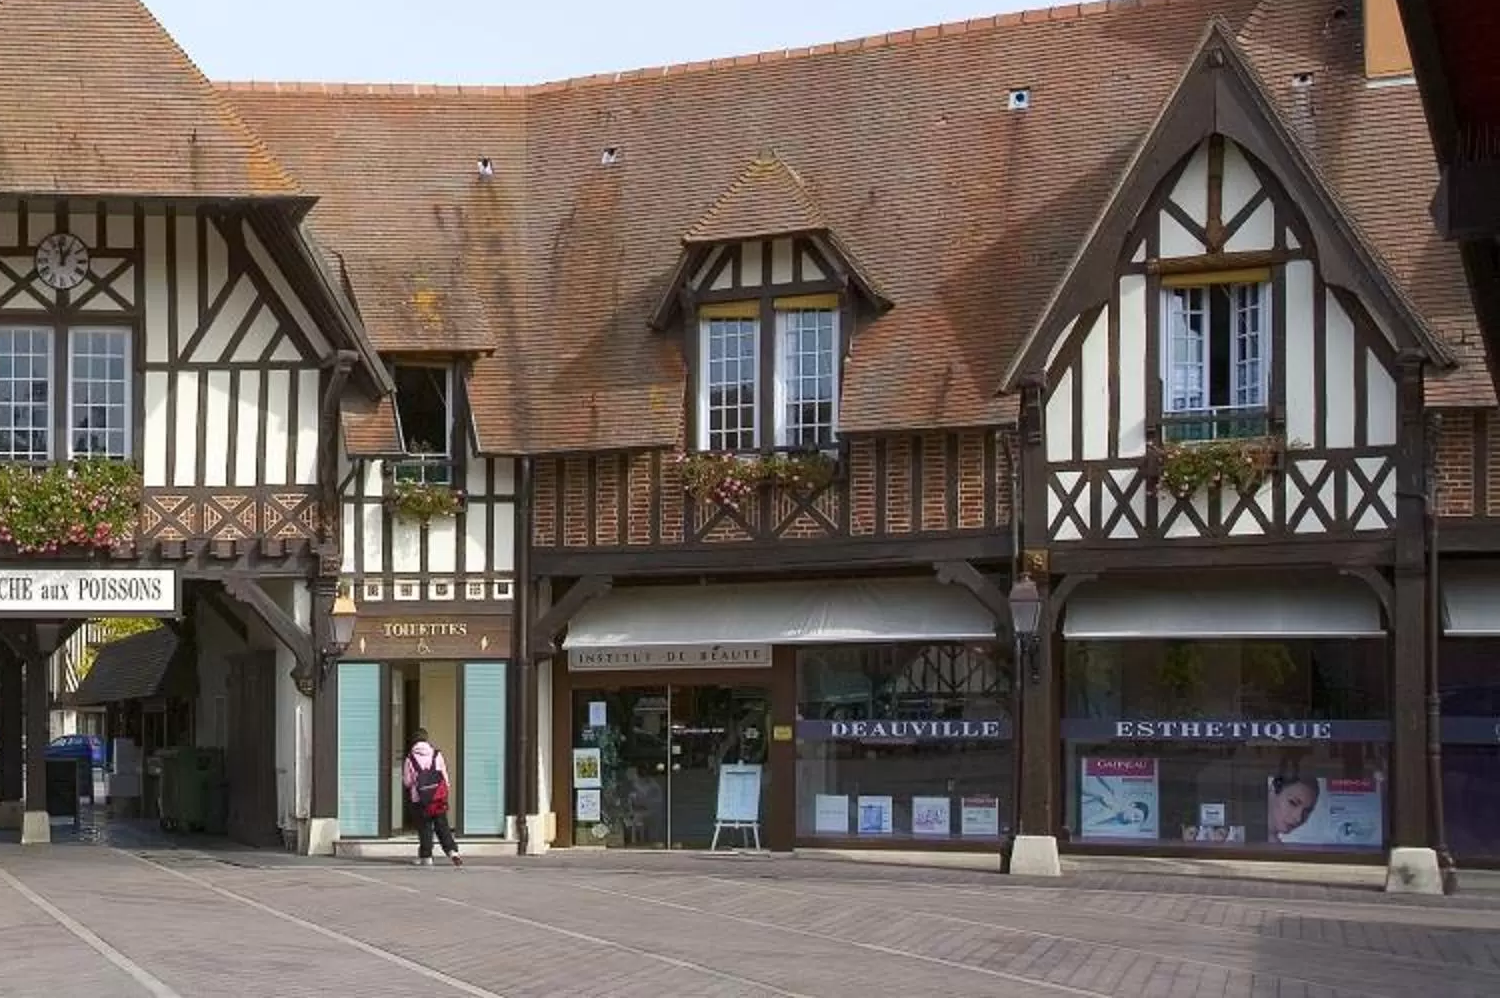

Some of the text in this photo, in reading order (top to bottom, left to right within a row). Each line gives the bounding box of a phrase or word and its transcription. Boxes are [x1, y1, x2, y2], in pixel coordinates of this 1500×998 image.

[41, 584, 69, 601] aux
[79, 577, 162, 601] POISSONS
[384, 622, 468, 637] TOILETTES
[831, 720, 1000, 737] DEAUVILLE
[1115, 720, 1332, 740] ESTHETIQUE
